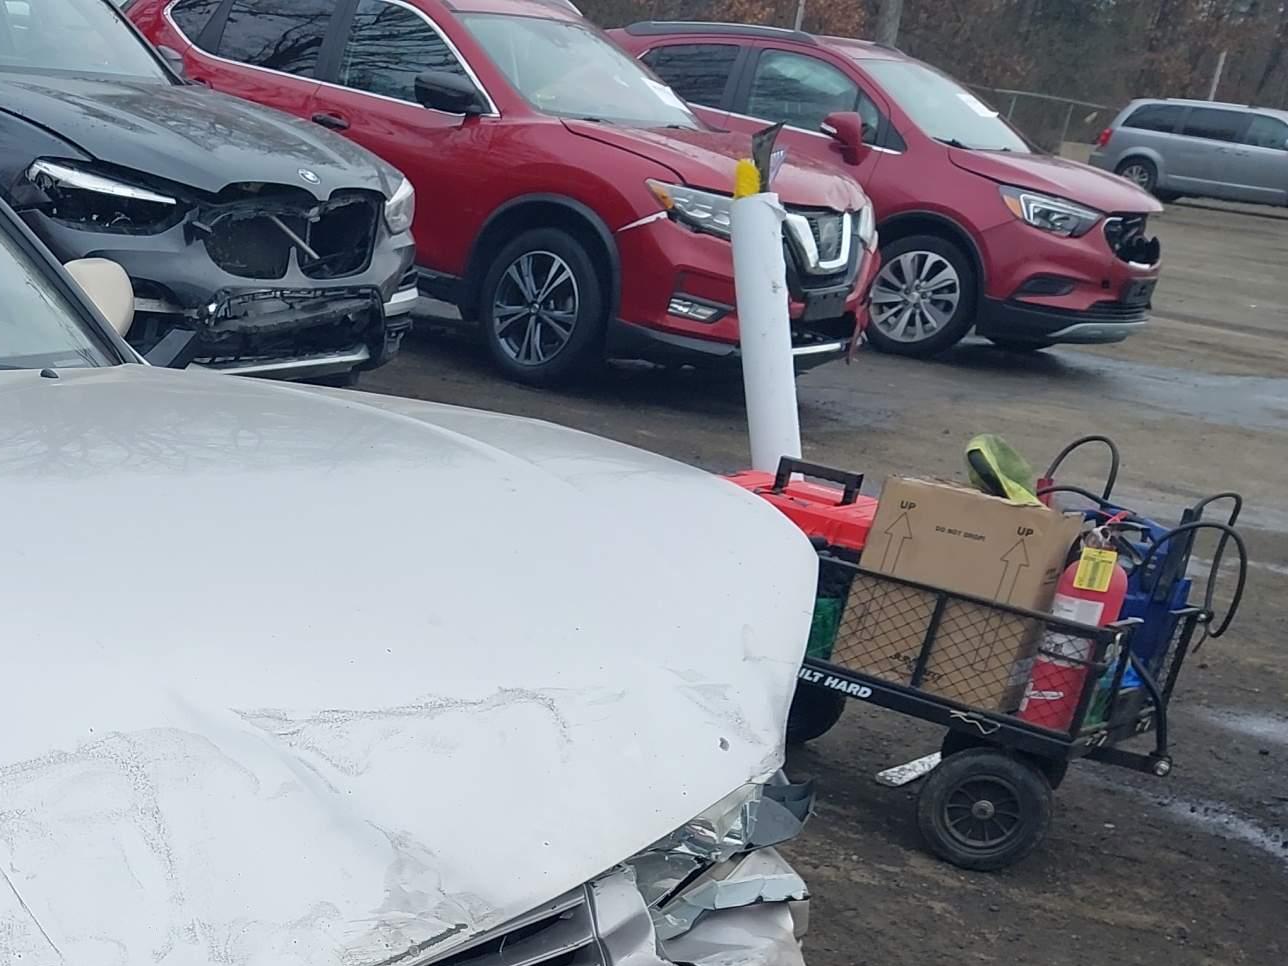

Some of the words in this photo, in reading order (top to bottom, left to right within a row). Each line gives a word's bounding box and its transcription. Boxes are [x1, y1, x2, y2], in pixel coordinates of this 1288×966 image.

[899, 500, 917, 511] UP
[1016, 526, 1034, 537] UP
[798, 668, 825, 683] ILT
[823, 676, 872, 698] HARD
